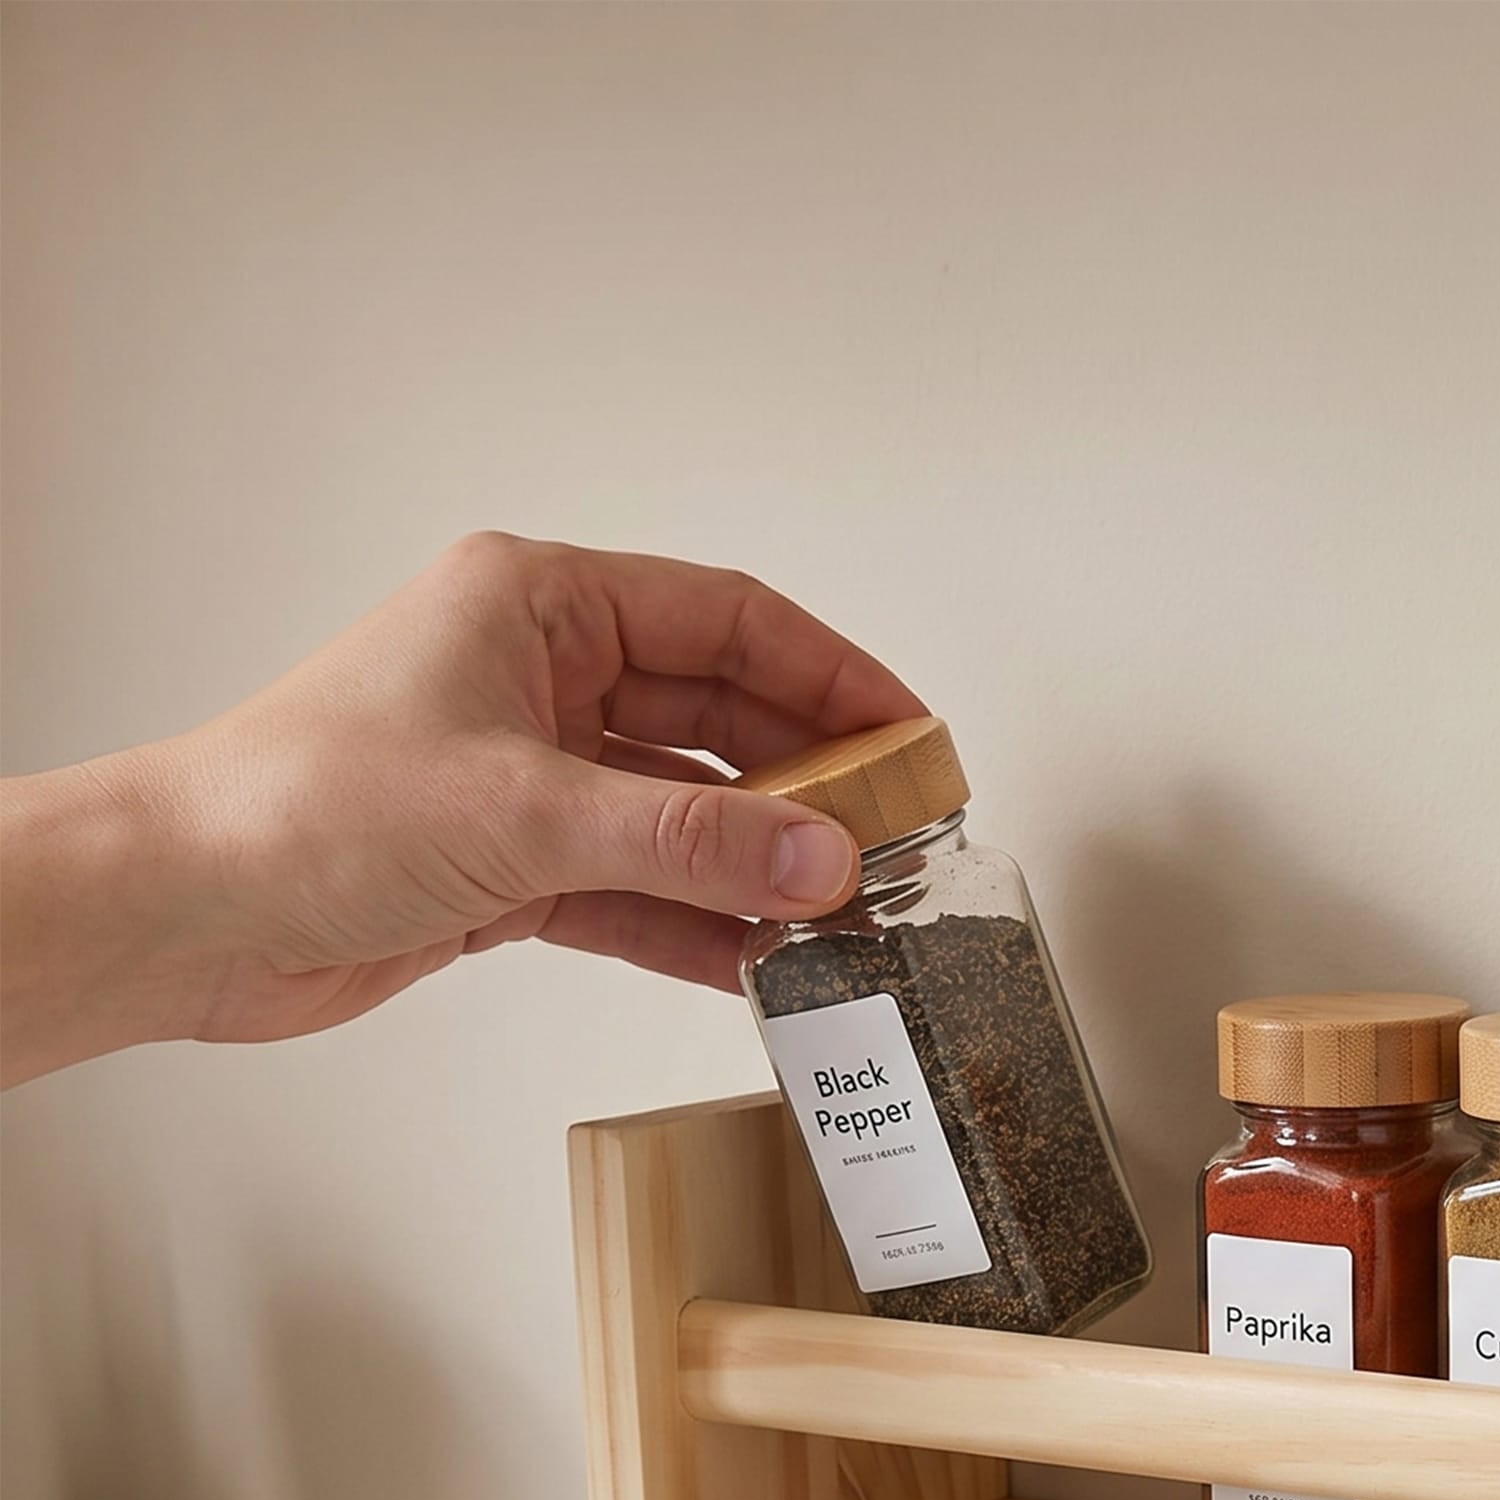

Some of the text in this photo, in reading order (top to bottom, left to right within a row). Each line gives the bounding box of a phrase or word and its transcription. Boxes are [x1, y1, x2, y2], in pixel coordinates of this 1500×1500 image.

[813, 1058, 890, 1098] Black
[815, 1100, 912, 1141] Pepper
[1225, 1306, 1332, 1346] Paprika
